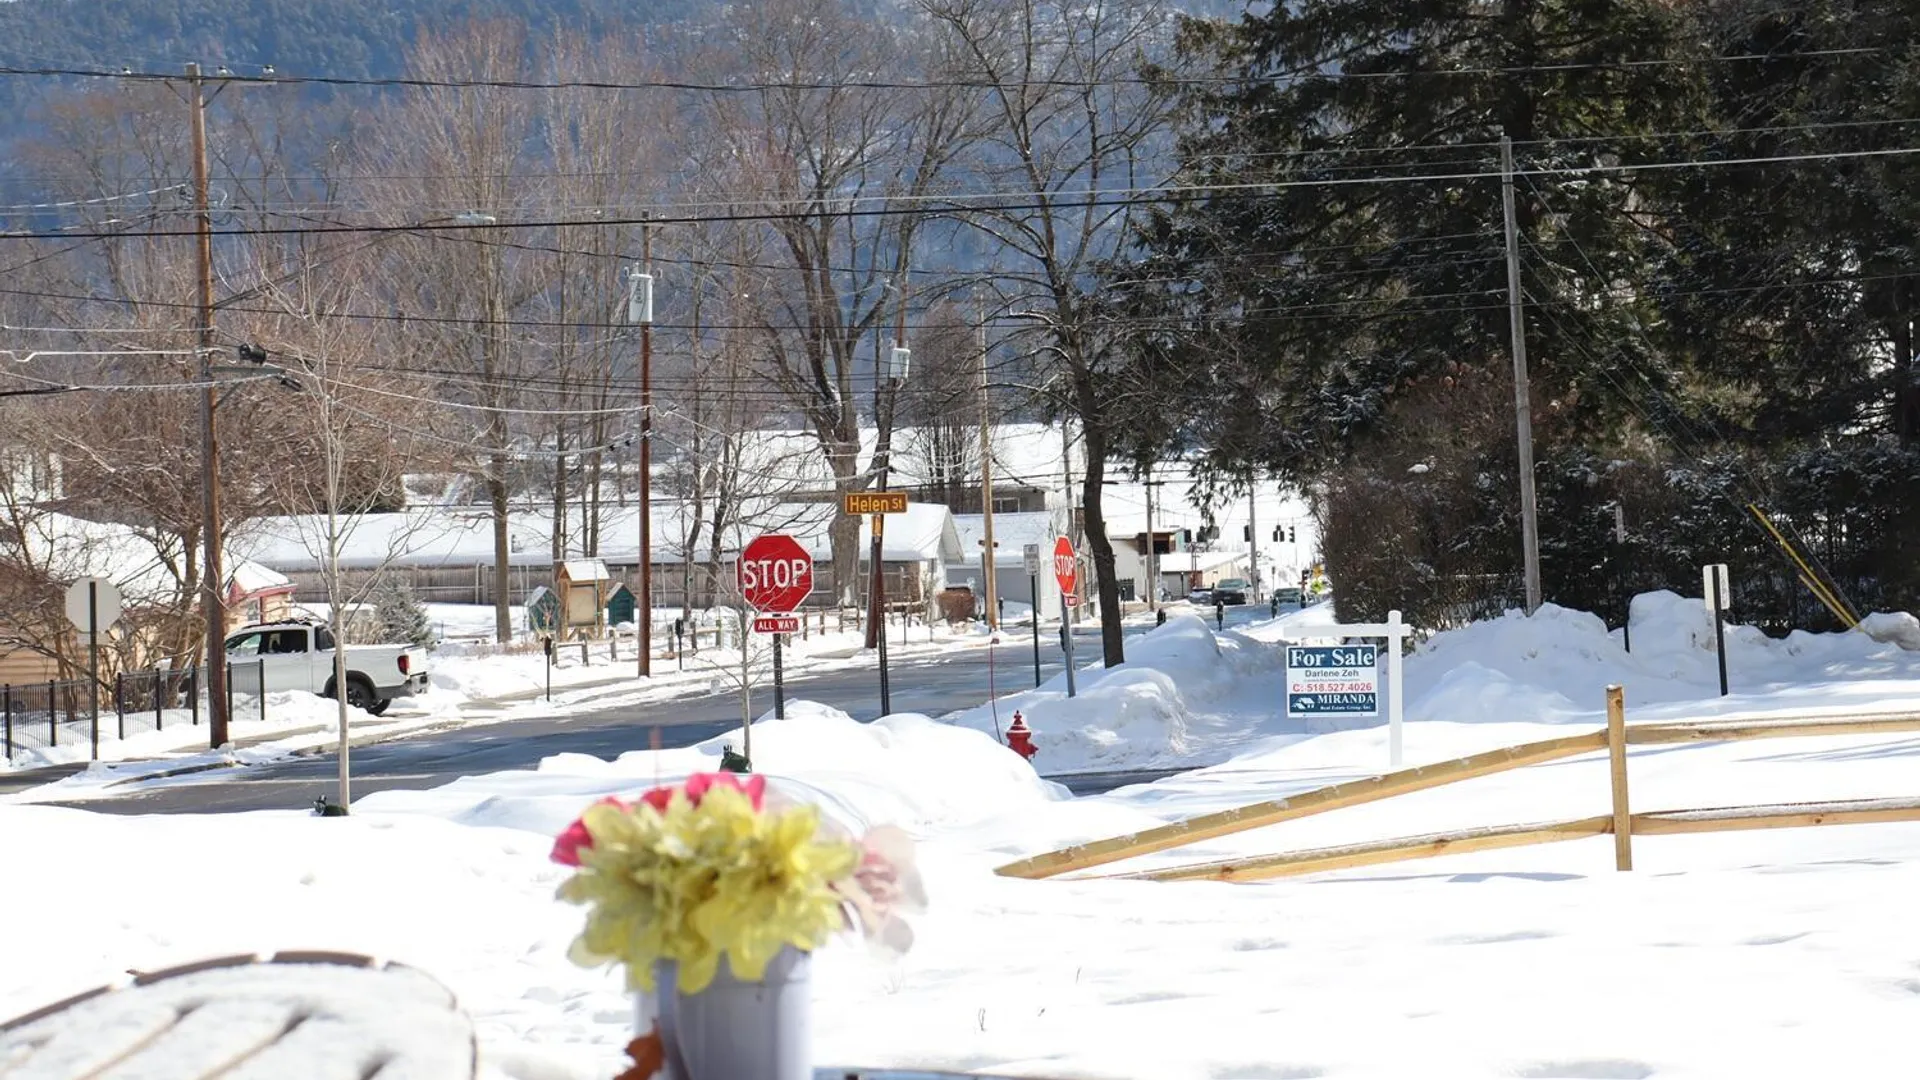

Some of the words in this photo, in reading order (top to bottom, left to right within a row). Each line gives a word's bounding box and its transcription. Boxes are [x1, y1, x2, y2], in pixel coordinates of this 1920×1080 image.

[850, 496, 889, 512] Helen
[891, 497, 903, 510] St
[1055, 555, 1074, 576] STOP
[743, 559, 807, 589] STOP
[758, 620, 774, 630] ALL
[777, 619, 795, 630] WAY
[1291, 649, 1325, 667] For
[1332, 648, 1374, 666] Sale
[1305, 669, 1340, 677] Darlene
[1341, 669, 1360, 677] Zeh
[1306, 682, 1372, 692] 518.527.4026
[1318, 694, 1374, 704] MIRANDA
